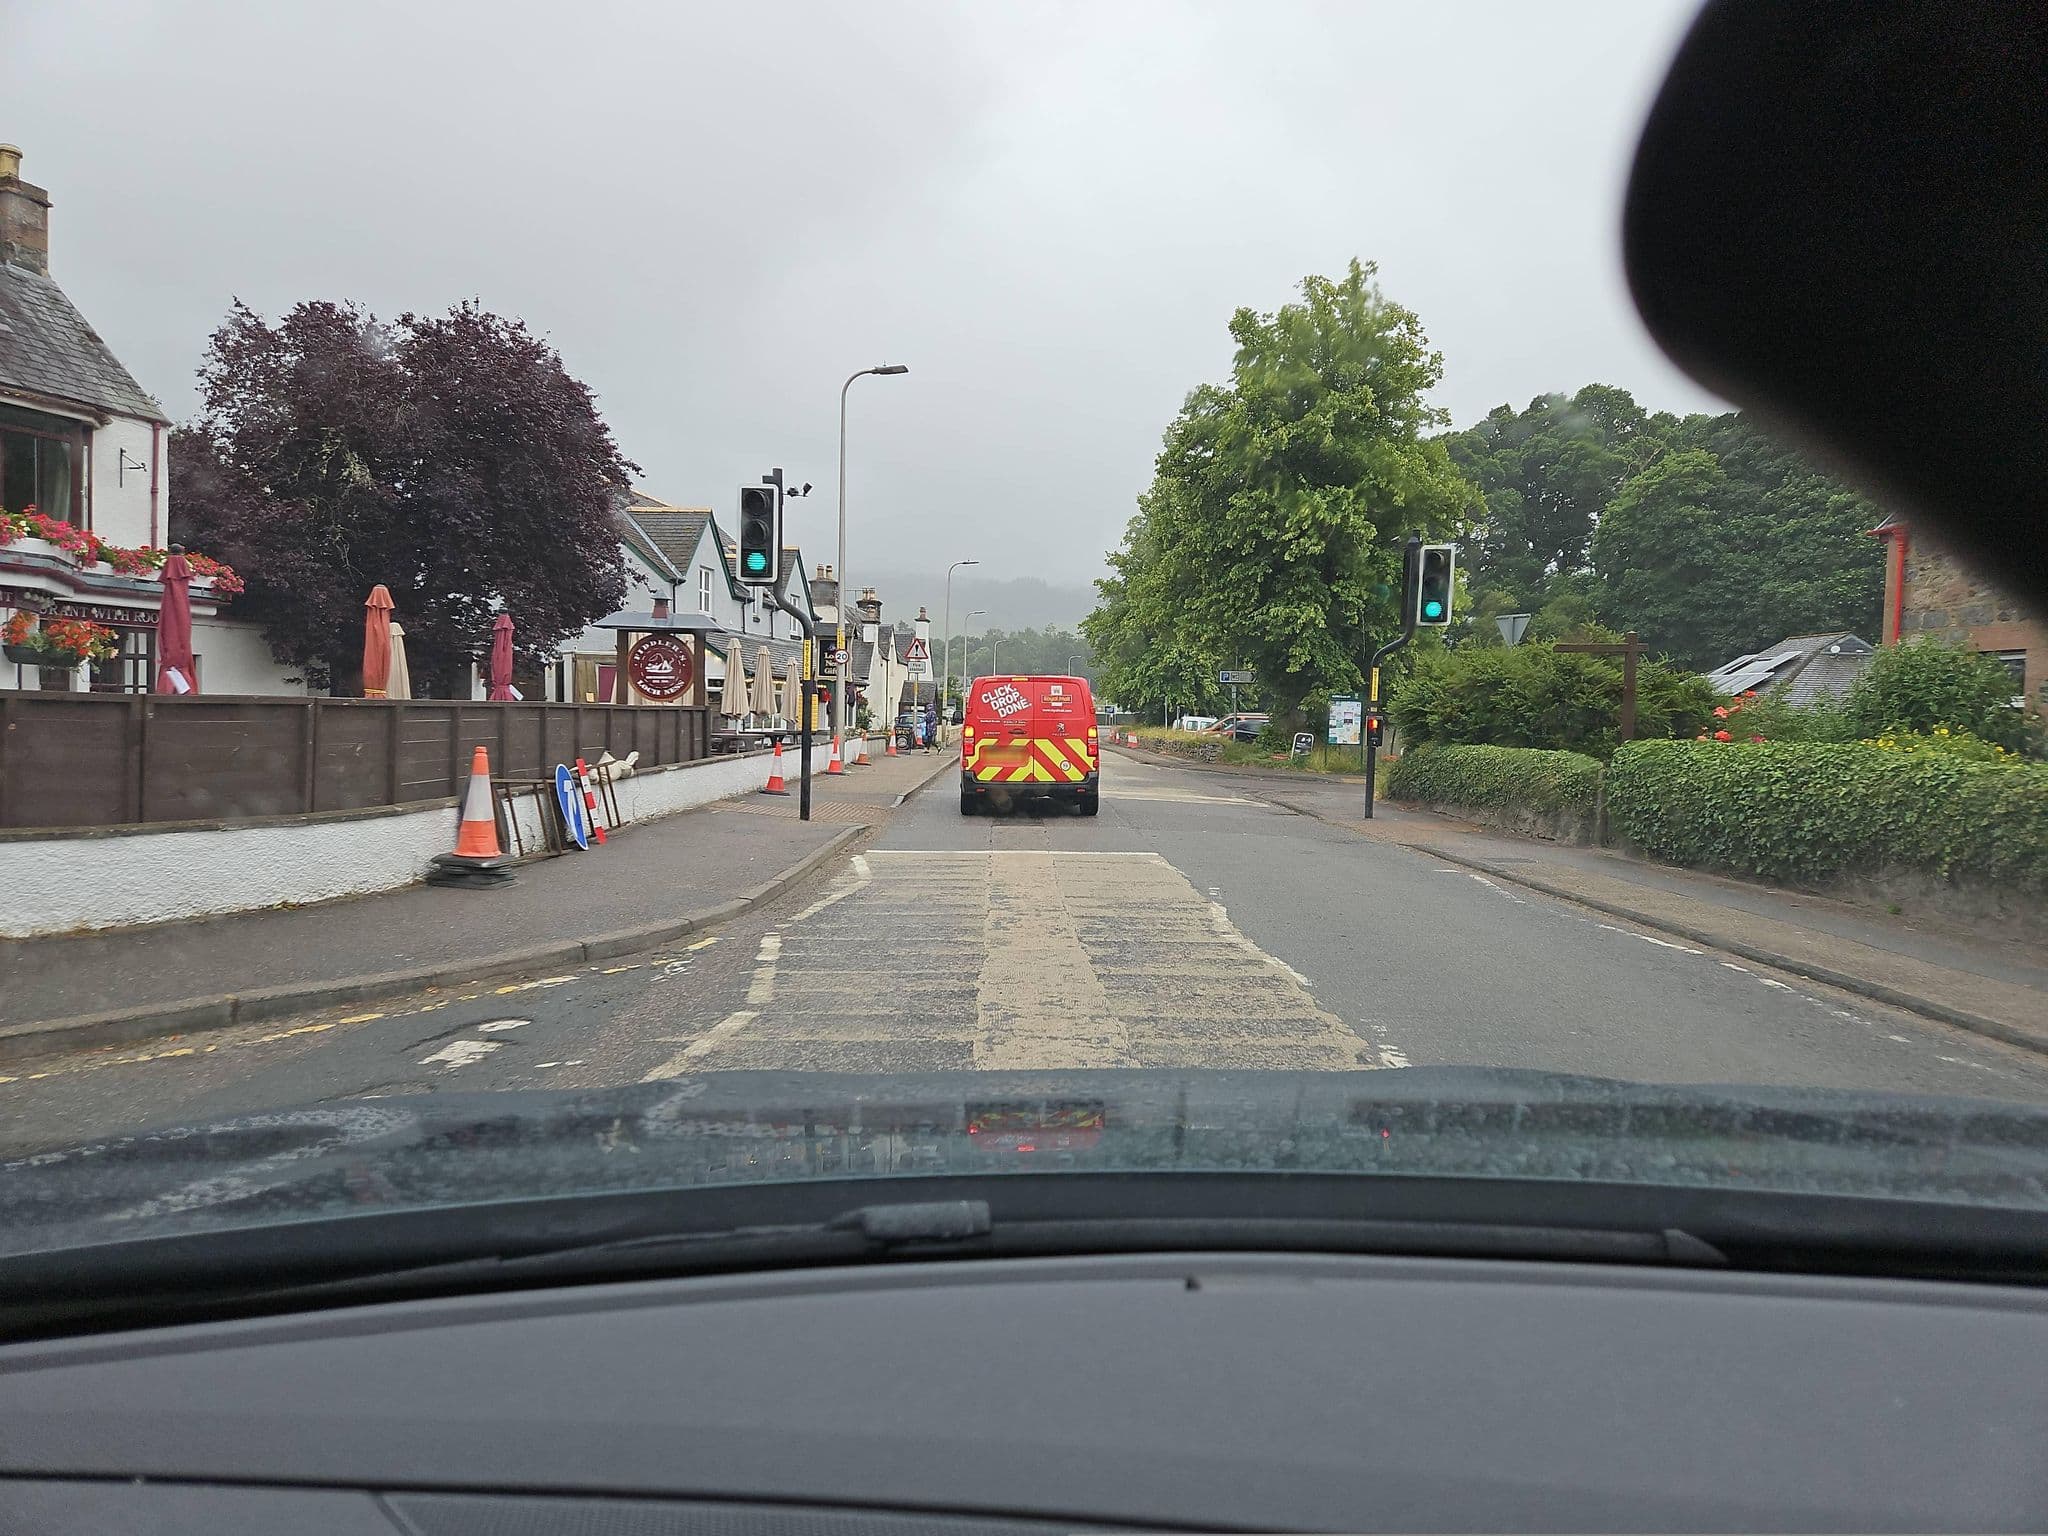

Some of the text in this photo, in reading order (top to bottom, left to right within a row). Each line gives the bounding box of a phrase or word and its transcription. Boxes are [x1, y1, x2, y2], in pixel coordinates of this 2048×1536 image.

[93, 607, 130, 621] WITH
[134, 611, 160, 624] ROO
[633, 640, 687, 661] FIDDLER'S
[637, 680, 661, 695] LOCH
[663, 679, 685, 695] NESS
[981, 683, 1017, 703] CLICK.
[990, 691, 1023, 710] DROP.
[997, 698, 1032, 718] DONE.
